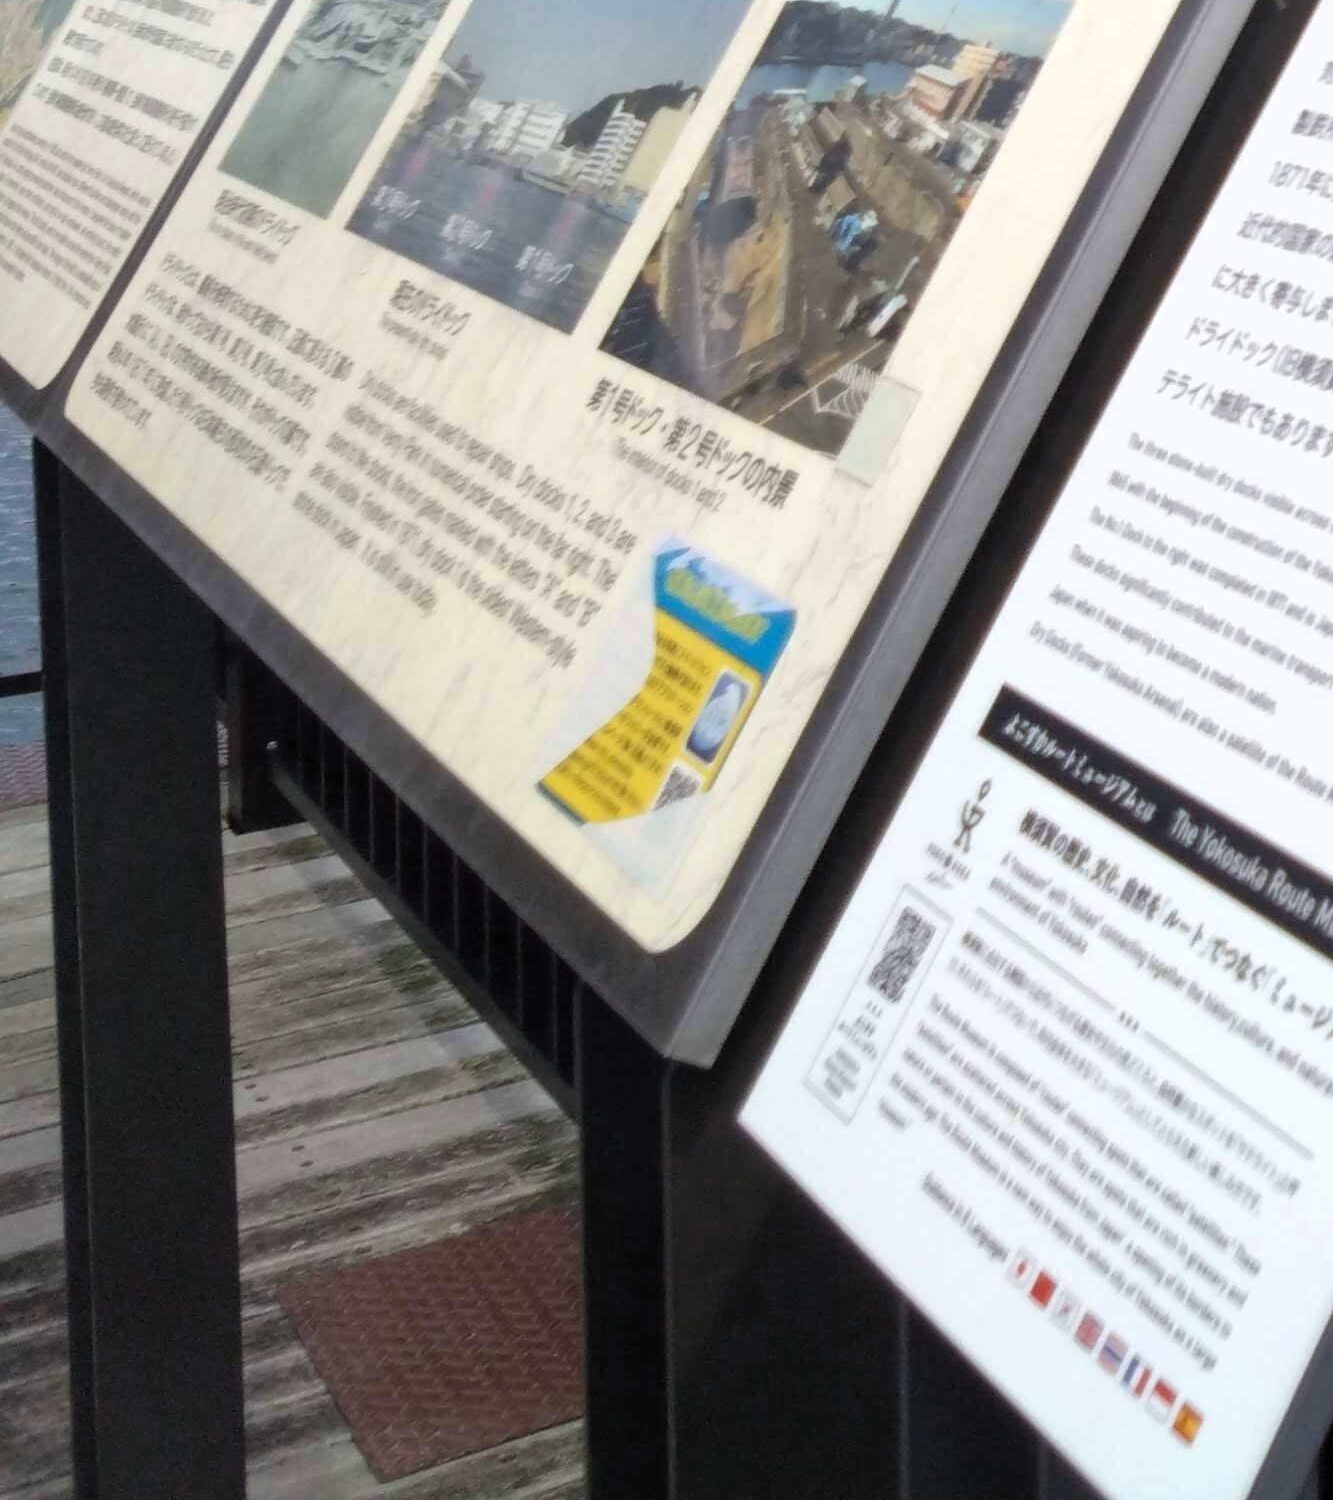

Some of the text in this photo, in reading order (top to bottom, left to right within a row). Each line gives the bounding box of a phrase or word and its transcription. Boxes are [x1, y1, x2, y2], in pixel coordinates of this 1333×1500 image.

[1169, 807, 1199, 848] The
[1197, 824, 1269, 891] Yokosuka
[1265, 867, 1316, 921] Route
